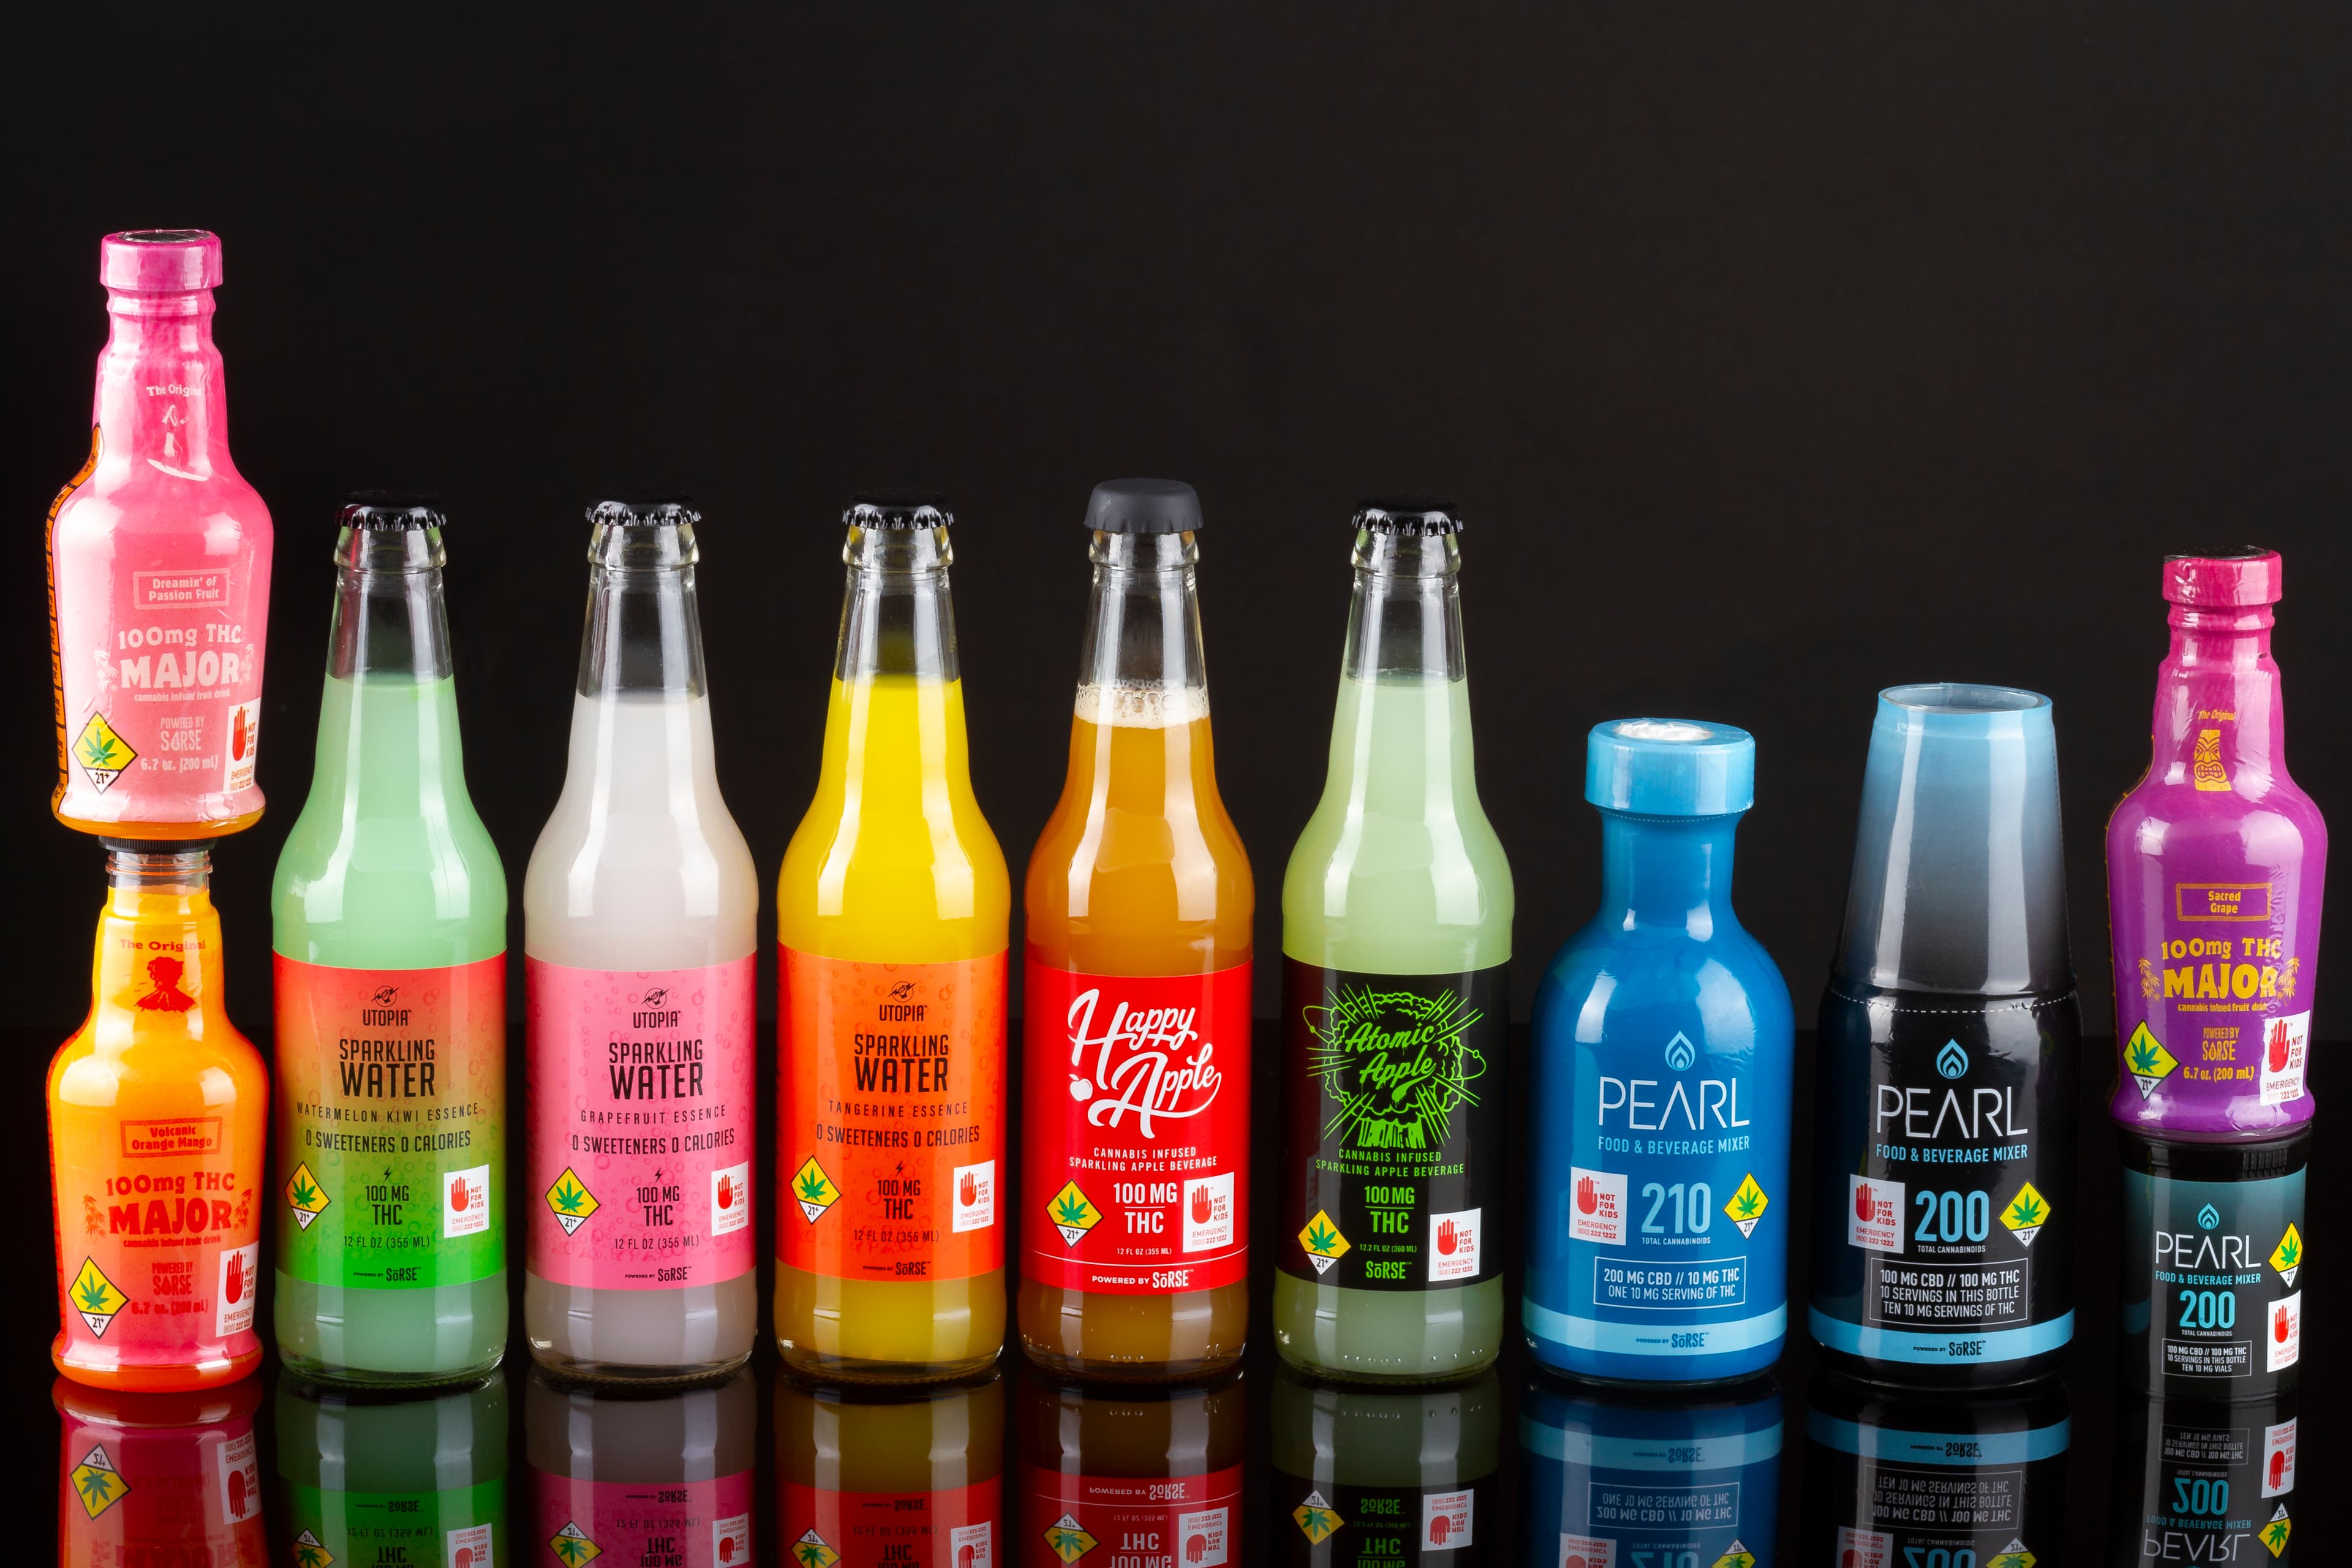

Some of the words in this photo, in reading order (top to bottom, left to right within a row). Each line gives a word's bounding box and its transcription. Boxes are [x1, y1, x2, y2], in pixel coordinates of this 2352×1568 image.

[146, 386, 166, 396] The
[206, 576, 217, 587] of
[148, 590, 193, 601] Passion
[196, 588, 219, 600] Fruit
[119, 627, 197, 649] 100mg
[206, 624, 243, 644] THC
[120, 650, 239, 689] MAJOR
[141, 758, 158, 771] 6.7
[162, 759, 176, 771] oz.
[179, 758, 199, 774] (200
[202, 755, 218, 771] mL)
[2208, 891, 2241, 902] Sacred
[2211, 902, 2238, 914] Grape
[120, 939, 143, 949] The
[148, 940, 206, 952] Original
[2162, 938, 2232, 960] 100mg
[2242, 938, 2282, 958] THC
[2163, 963, 2278, 999] MAJOR
[854, 1034, 948, 1057] SPARKLING
[1068, 989, 1198, 1090] Happy
[1345, 1022, 1436, 1053] Atomic
[339, 1039, 435, 1061] SPARKLING
[609, 1039, 703, 1063] SPARKLING
[341, 1061, 435, 1098] WATER
[855, 1057, 948, 1093] WATER
[1359, 1044, 1436, 1097] Apple
[610, 1062, 703, 1099] WATER
[1088, 1043, 1221, 1139] Apple
[297, 1101, 377, 1122] WATERMELON
[387, 1110, 418, 1122] KIWI
[428, 1103, 478, 1121] ESSENCE
[581, 1110, 665, 1125] GRAPEFRUIT
[674, 1105, 725, 1123] ESSENCE
[829, 1101, 904, 1117] TANGERINE
[913, 1102, 967, 1117] ESSENCE
[150, 1126, 196, 1137] Volcanic
[584, 1136, 666, 1154] SWEETENERS
[685, 1128, 734, 1152] CALORIES
[132, 1138, 175, 1151] Orange
[178, 1137, 212, 1148] Mango
[316, 1131, 395, 1153] SWEETENERS
[415, 1130, 470, 1152] CALORIES
[1599, 1136, 1629, 1152] FOOD
[1634, 1140, 1643, 1153] &
[1648, 1140, 1713, 1155] BEVERAGE
[1718, 1136, 1749, 1153] MIXER
[1094, 1147, 1147, 1159] CANNABIS
[1153, 1147, 1196, 1158] INFUSED
[1339, 1149, 1390, 1162] CANNABIS
[1396, 1152, 1441, 1163] INFUSED
[1876, 1143, 1906, 1160] FOOD
[1911, 1148, 1918, 1161] &
[1923, 1148, 1989, 1163] BEVERAGE
[1993, 1144, 2028, 1162] MIXER
[1069, 1157, 1126, 1171] SPARKLING
[1131, 1163, 1164, 1171] APPLE
[1170, 1156, 1217, 1170] BEVERAGE
[1316, 1159, 1369, 1175] SPARKLING
[1375, 1166, 1408, 1177] APPLE
[1414, 1164, 1464, 1177] BEVERAGE
[107, 1174, 185, 1196] 100mg
[194, 1172, 235, 1191] THC
[365, 1185, 386, 1202] 100
[391, 1185, 409, 1202] MG
[877, 1180, 899, 1196] 100
[903, 1180, 921, 1196] MG
[1113, 1183, 1145, 1204] 100
[1150, 1183, 1177, 1204] MG
[636, 1187, 658, 1203] 100
[662, 1186, 680, 1202] MG
[1214, 1196, 1226, 1204] NOT
[1365, 1186, 1389, 1204] 100
[1392, 1187, 1415, 1204] MG
[109, 1197, 232, 1235] MAJOR
[372, 1205, 402, 1225] THC
[644, 1205, 673, 1226] THC
[883, 1199, 913, 1219] THC
[1214, 1212, 1228, 1221] KIDS
[1642, 1182, 1711, 1234] 210
[1915, 1190, 1989, 1242] 200
[1125, 1212, 1164, 1234] THC
[1193, 1226, 1227, 1238] EMERGENCY
[1370, 1212, 1409, 1234] THC
[344, 1236, 353, 1247] 12
[357, 1237, 367, 1248] FL
[371, 1237, 382, 1248] OZ
[386, 1237, 409, 1249] (355
[413, 1235, 429, 1249] ML)
[1145, 1248, 1159, 1256] (355
[1161, 1246, 1172, 1256] ML)
[1918, 1245, 1936, 1253] TOTAL
[1937, 1245, 1986, 1254] CANNABINOIDS
[244, 1265, 254, 1278] NOT
[1092, 1275, 1135, 1284] POWERED
[1604, 1268, 1623, 1283] 200
[1627, 1270, 1644, 1284] MG
[1648, 1272, 1672, 1286] CBD
[1688, 1271, 1699, 1284] 10
[1703, 1269, 1719, 1284] MG
[1722, 1267, 1740, 1282] THC
[1880, 1269, 1898, 1284] 100
[1901, 1271, 1917, 1286] MG
[1921, 1272, 1943, 1287] CBD
[1960, 1273, 1978, 1287] 100
[1982, 1272, 1997, 1286] MG
[2000, 1269, 2019, 1284] THC
[2155, 1270, 2176, 1282] FOOD
[2178, 1274, 2185, 1284] &
[2188, 1275, 2233, 1285] BEVERAGE
[2236, 1273, 2261, 1284] MIXER
[244, 1279, 253, 1289] FOR
[1608, 1285, 1627, 1298] ONE
[1631, 1287, 1641, 1299] 10
[1644, 1287, 1659, 1300] MG
[1662, 1287, 1703, 1300] SERVING
[1706, 1286, 1717, 1298] OF
[1720, 1284, 1735, 1297] THC
[1880, 1286, 1890, 1299] 10
[1893, 1287, 1942, 1302] SERVINGS
[1947, 1289, 1956, 1302] IN
[1960, 1289, 1983, 1302] THIS
[1986, 1285, 2019, 1301] BOTTLE
[243, 1289, 254, 1302] KIDS
[224, 1307, 252, 1323] EMERGENCY
[2179, 1290, 2235, 1329] 200
